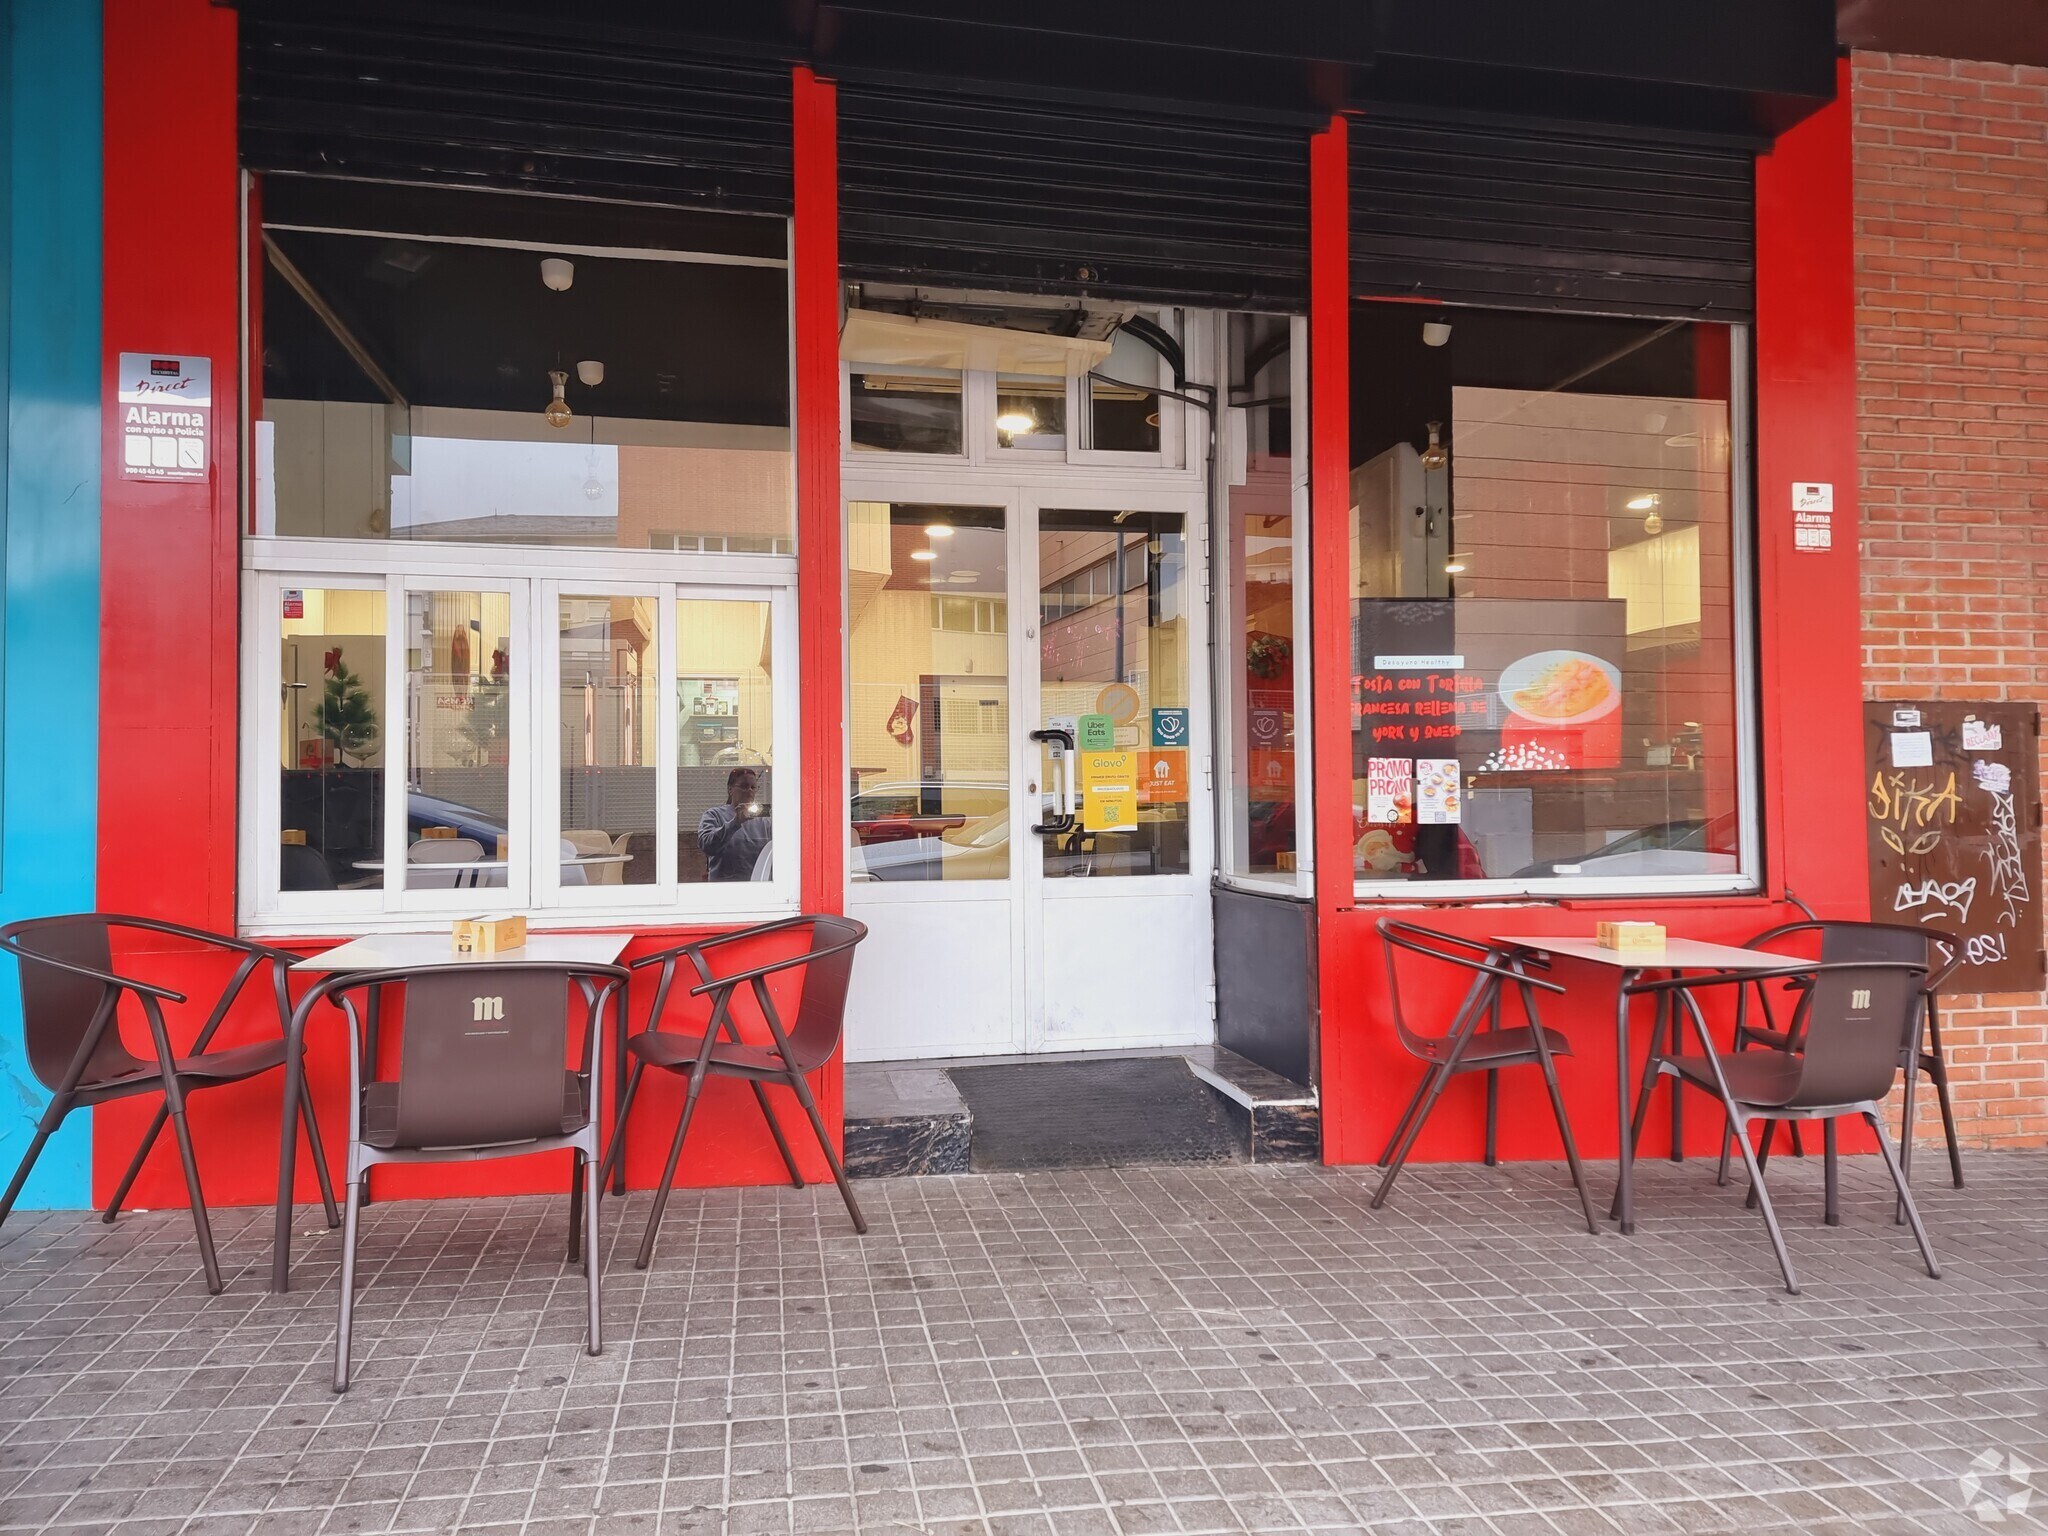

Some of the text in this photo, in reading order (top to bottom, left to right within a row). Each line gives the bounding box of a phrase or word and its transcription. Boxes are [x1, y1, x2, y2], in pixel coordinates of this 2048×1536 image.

[136, 377, 196, 397] Direct
[125, 406, 204, 427] Alarma
[143, 426, 166, 434] aviso
[1795, 512, 1831, 523] Alarma
[1087, 721, 1105, 729] Uber
[1093, 757, 1123, 768] Glovo
[1368, 760, 1412, 779] PROMO
[1370, 778, 1413, 796] PROMO
[1851, 989, 1871, 1009] m
[472, 996, 505, 1021] m
